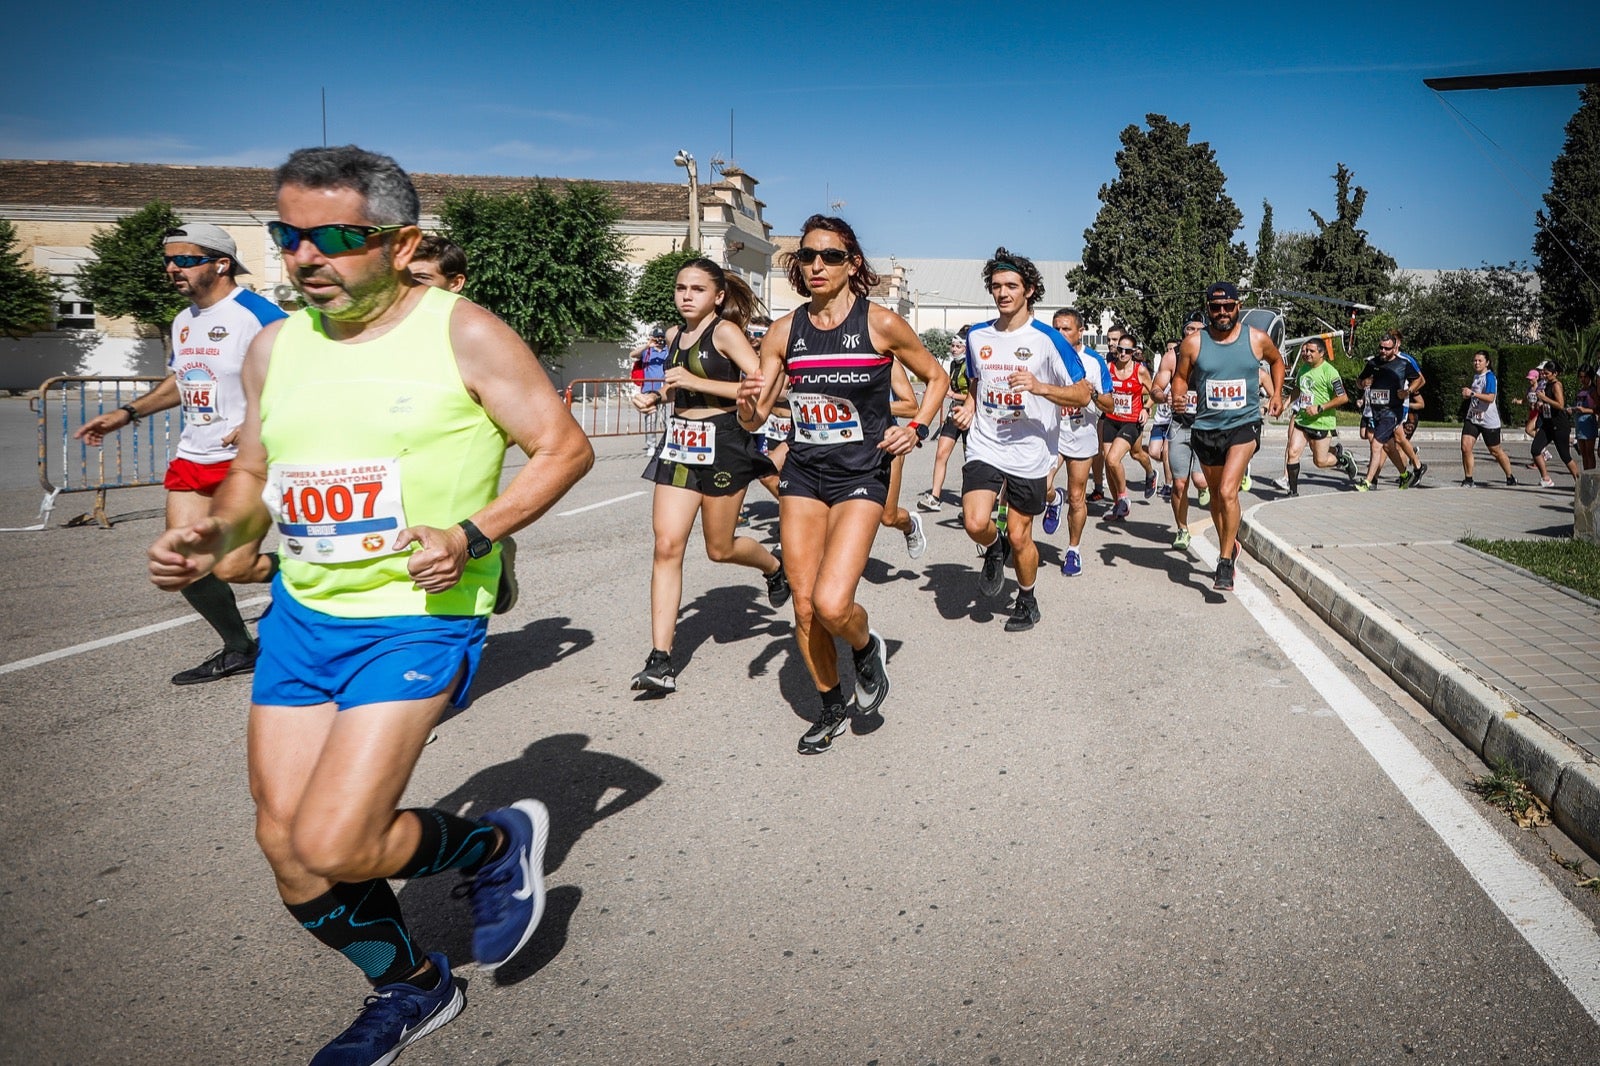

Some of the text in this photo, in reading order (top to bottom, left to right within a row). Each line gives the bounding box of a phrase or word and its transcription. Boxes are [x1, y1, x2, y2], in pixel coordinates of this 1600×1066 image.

[987, 391, 1022, 405] 1168
[1212, 386, 1241, 397] 1181
[800, 403, 852, 424] 1103
[672, 429, 707, 447] 1121
[321, 468, 347, 477] BASE
[282, 481, 383, 523] 1007
